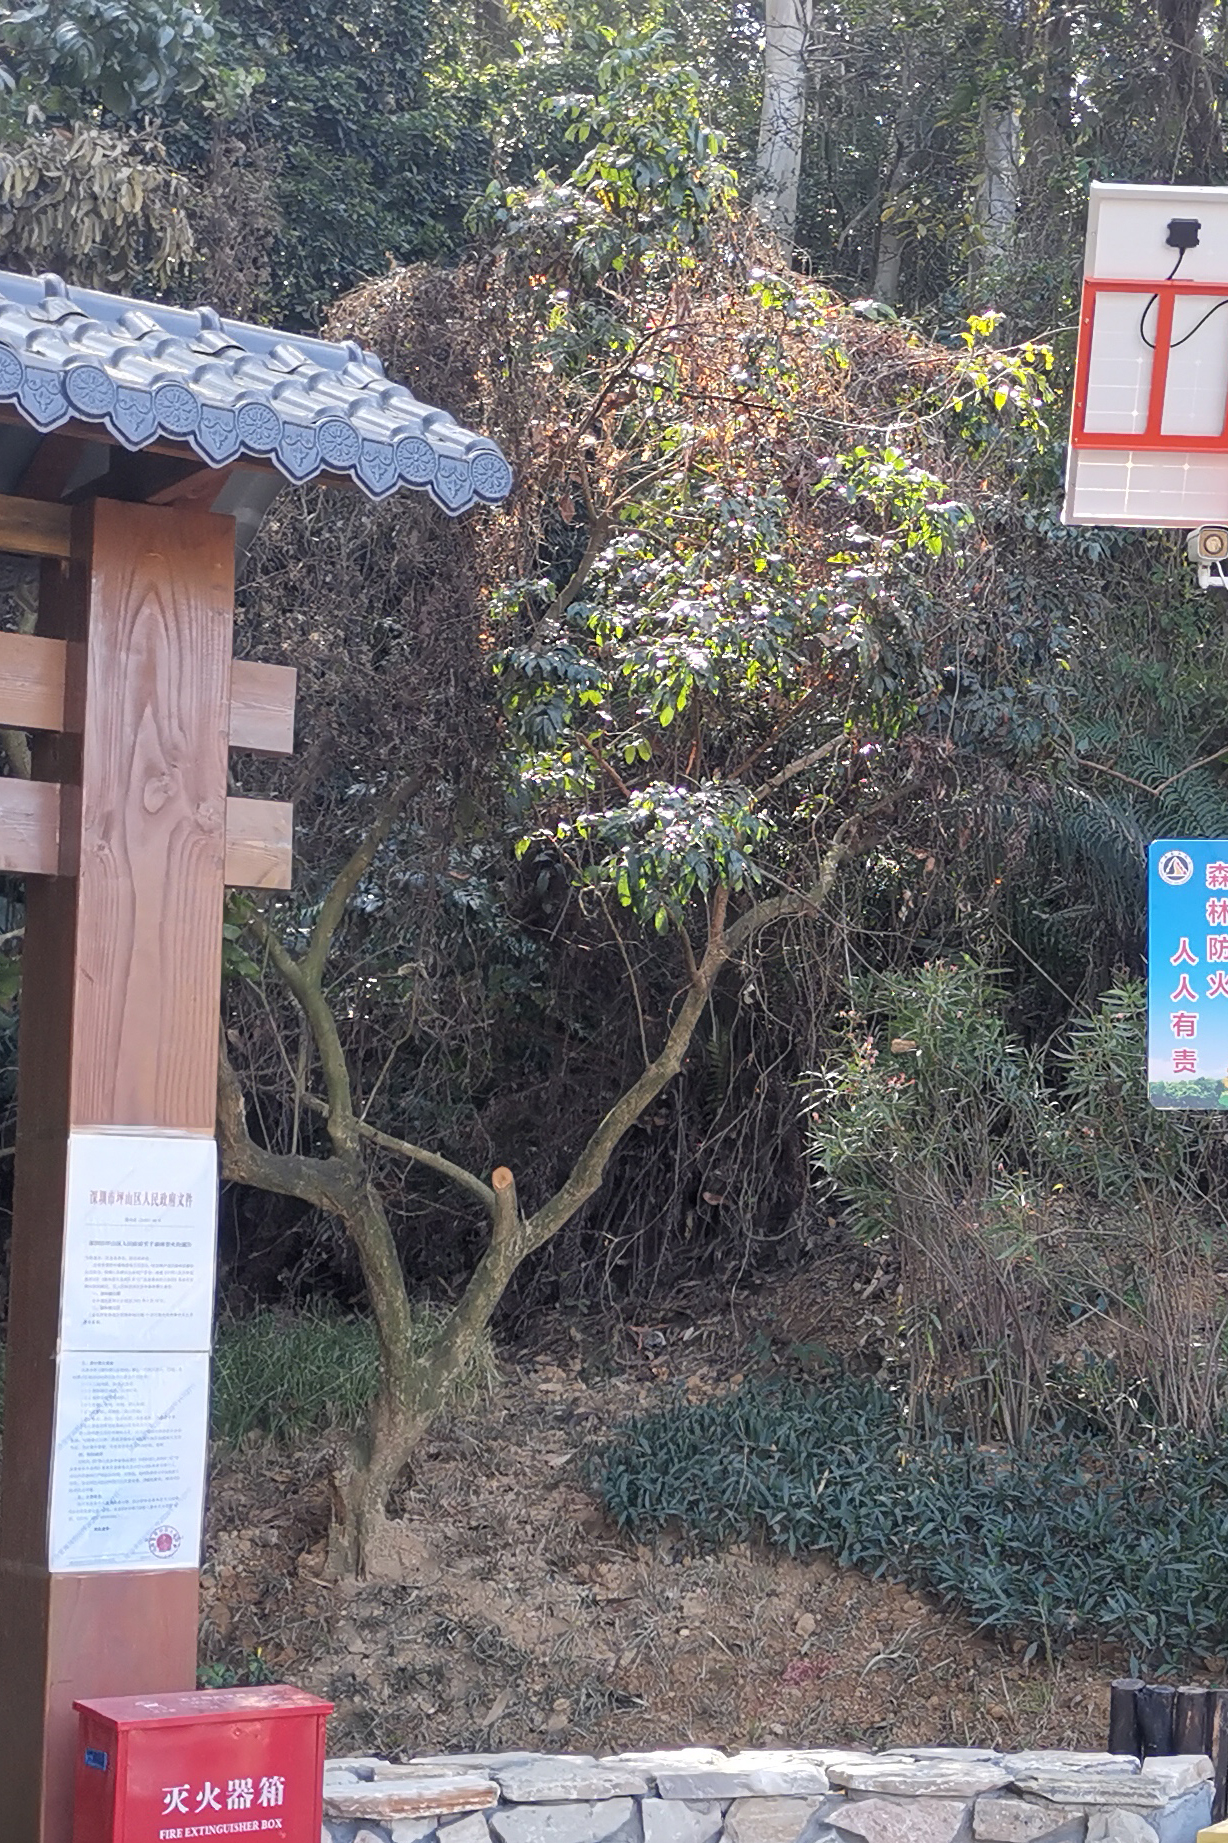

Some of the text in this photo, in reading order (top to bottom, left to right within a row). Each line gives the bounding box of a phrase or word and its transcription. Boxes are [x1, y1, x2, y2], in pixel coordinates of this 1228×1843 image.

[1170, 938, 1198, 1074] 人人有责
[161, 1775, 286, 1815] 灭火器箱
[159, 1818, 283, 1840] FIRE EXTINGUISHER BOX
